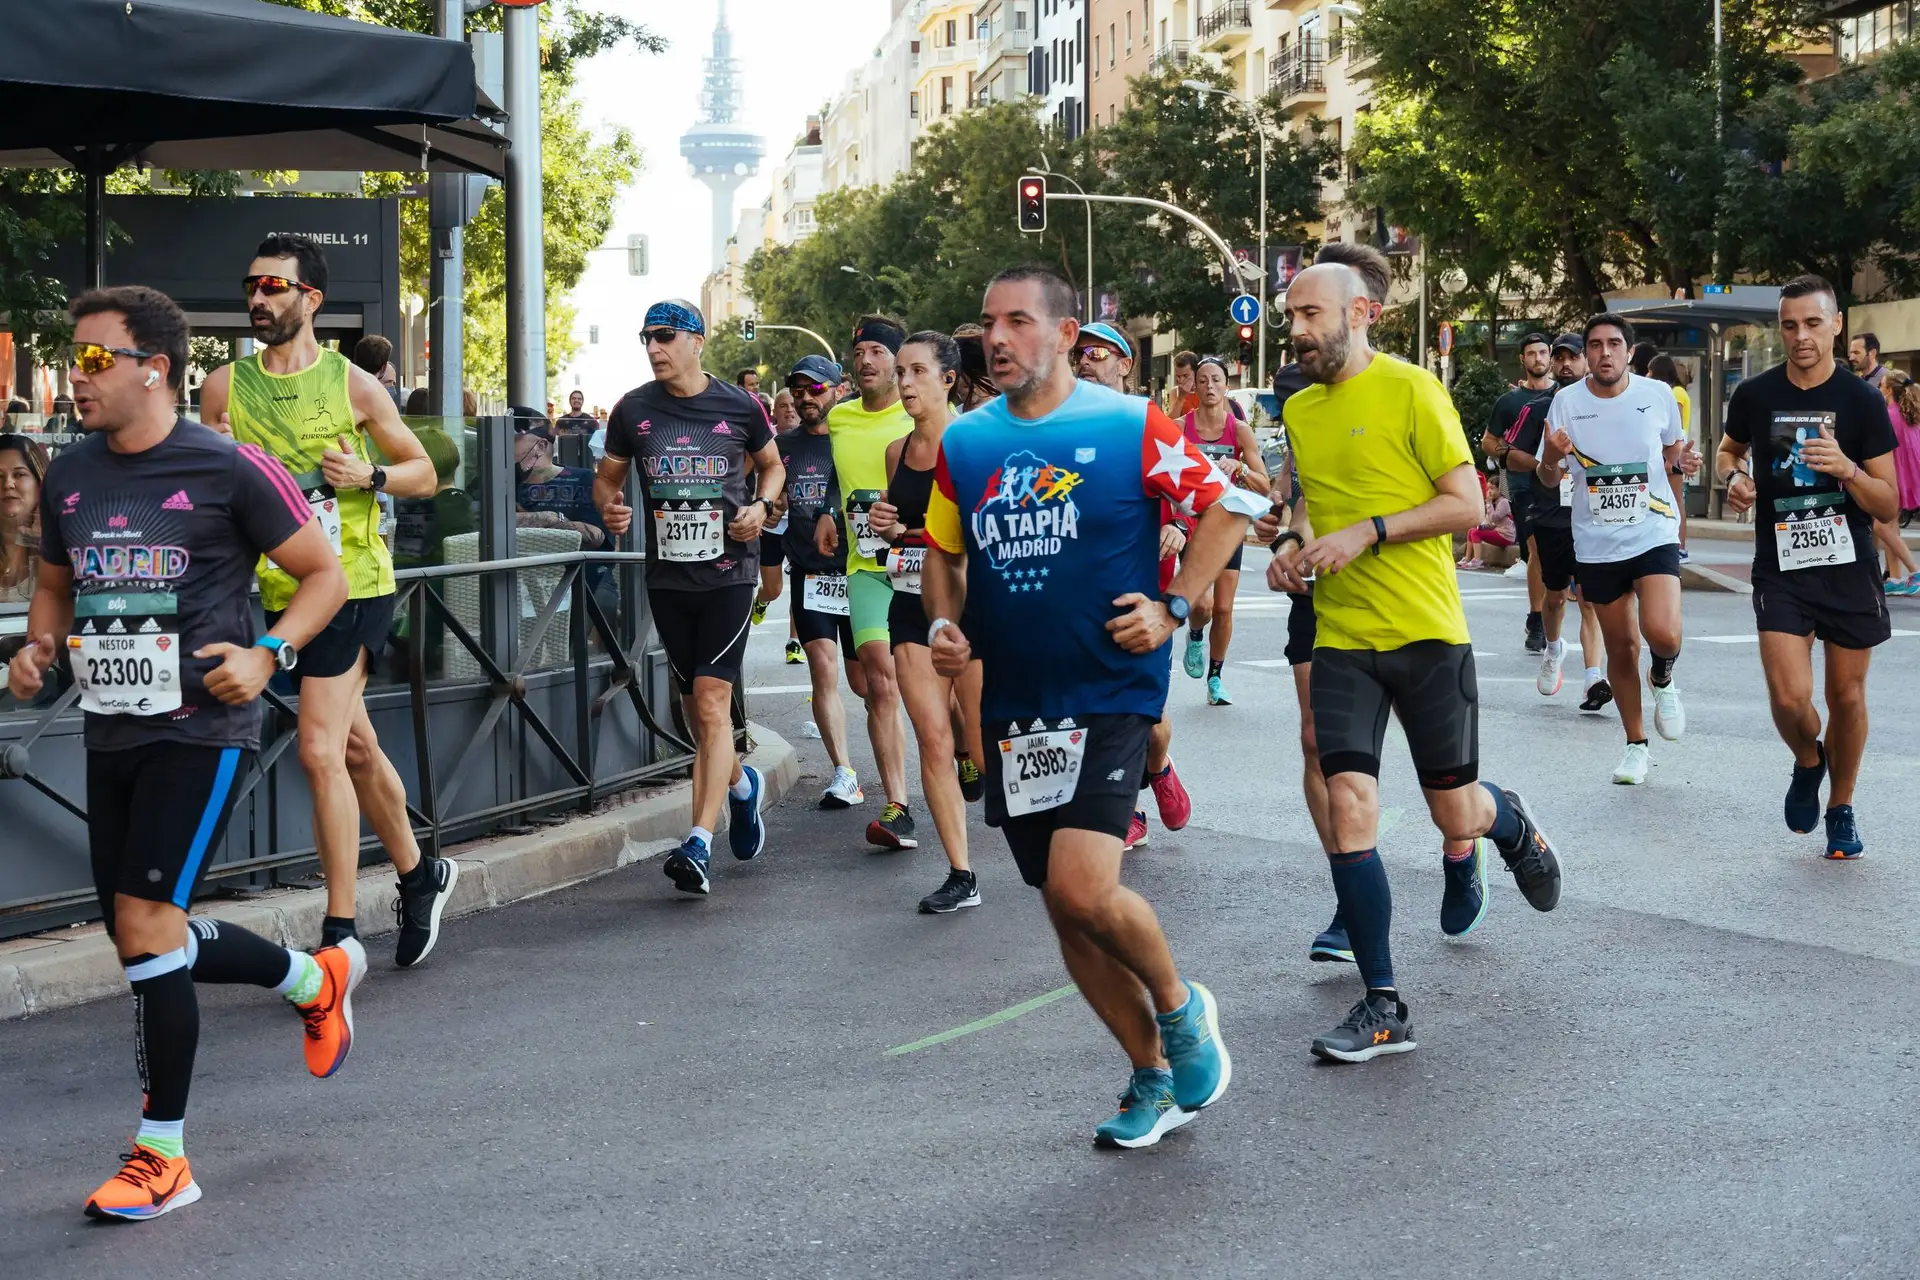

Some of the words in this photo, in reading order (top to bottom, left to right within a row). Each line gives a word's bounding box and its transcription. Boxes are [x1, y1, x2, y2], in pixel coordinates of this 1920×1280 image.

[267, 232, 348, 245] O'NNELL
[353, 233, 368, 245] 11
[642, 455, 729, 477] MADRID
[677, 487, 692, 498] edp
[1624, 485, 1638, 493] 2020
[162, 502, 194, 511] adidas
[1600, 493, 1637, 509] 24367
[108, 513, 128, 529] edp
[971, 511, 1002, 551] LA
[1004, 501, 1078, 540] TAPIA
[1791, 522, 1813, 531] MARIO
[1820, 519, 1832, 527] LEO
[666, 522, 708, 541] 23177
[1791, 527, 1836, 549] 23561
[998, 537, 1062, 560] MADRID
[108, 597, 127, 612] edp
[98, 636, 135, 650] NÉSTOR
[87, 657, 153, 686] 23300
[1027, 736, 1049, 749] JAIME
[1017, 747, 1067, 781] 23983
